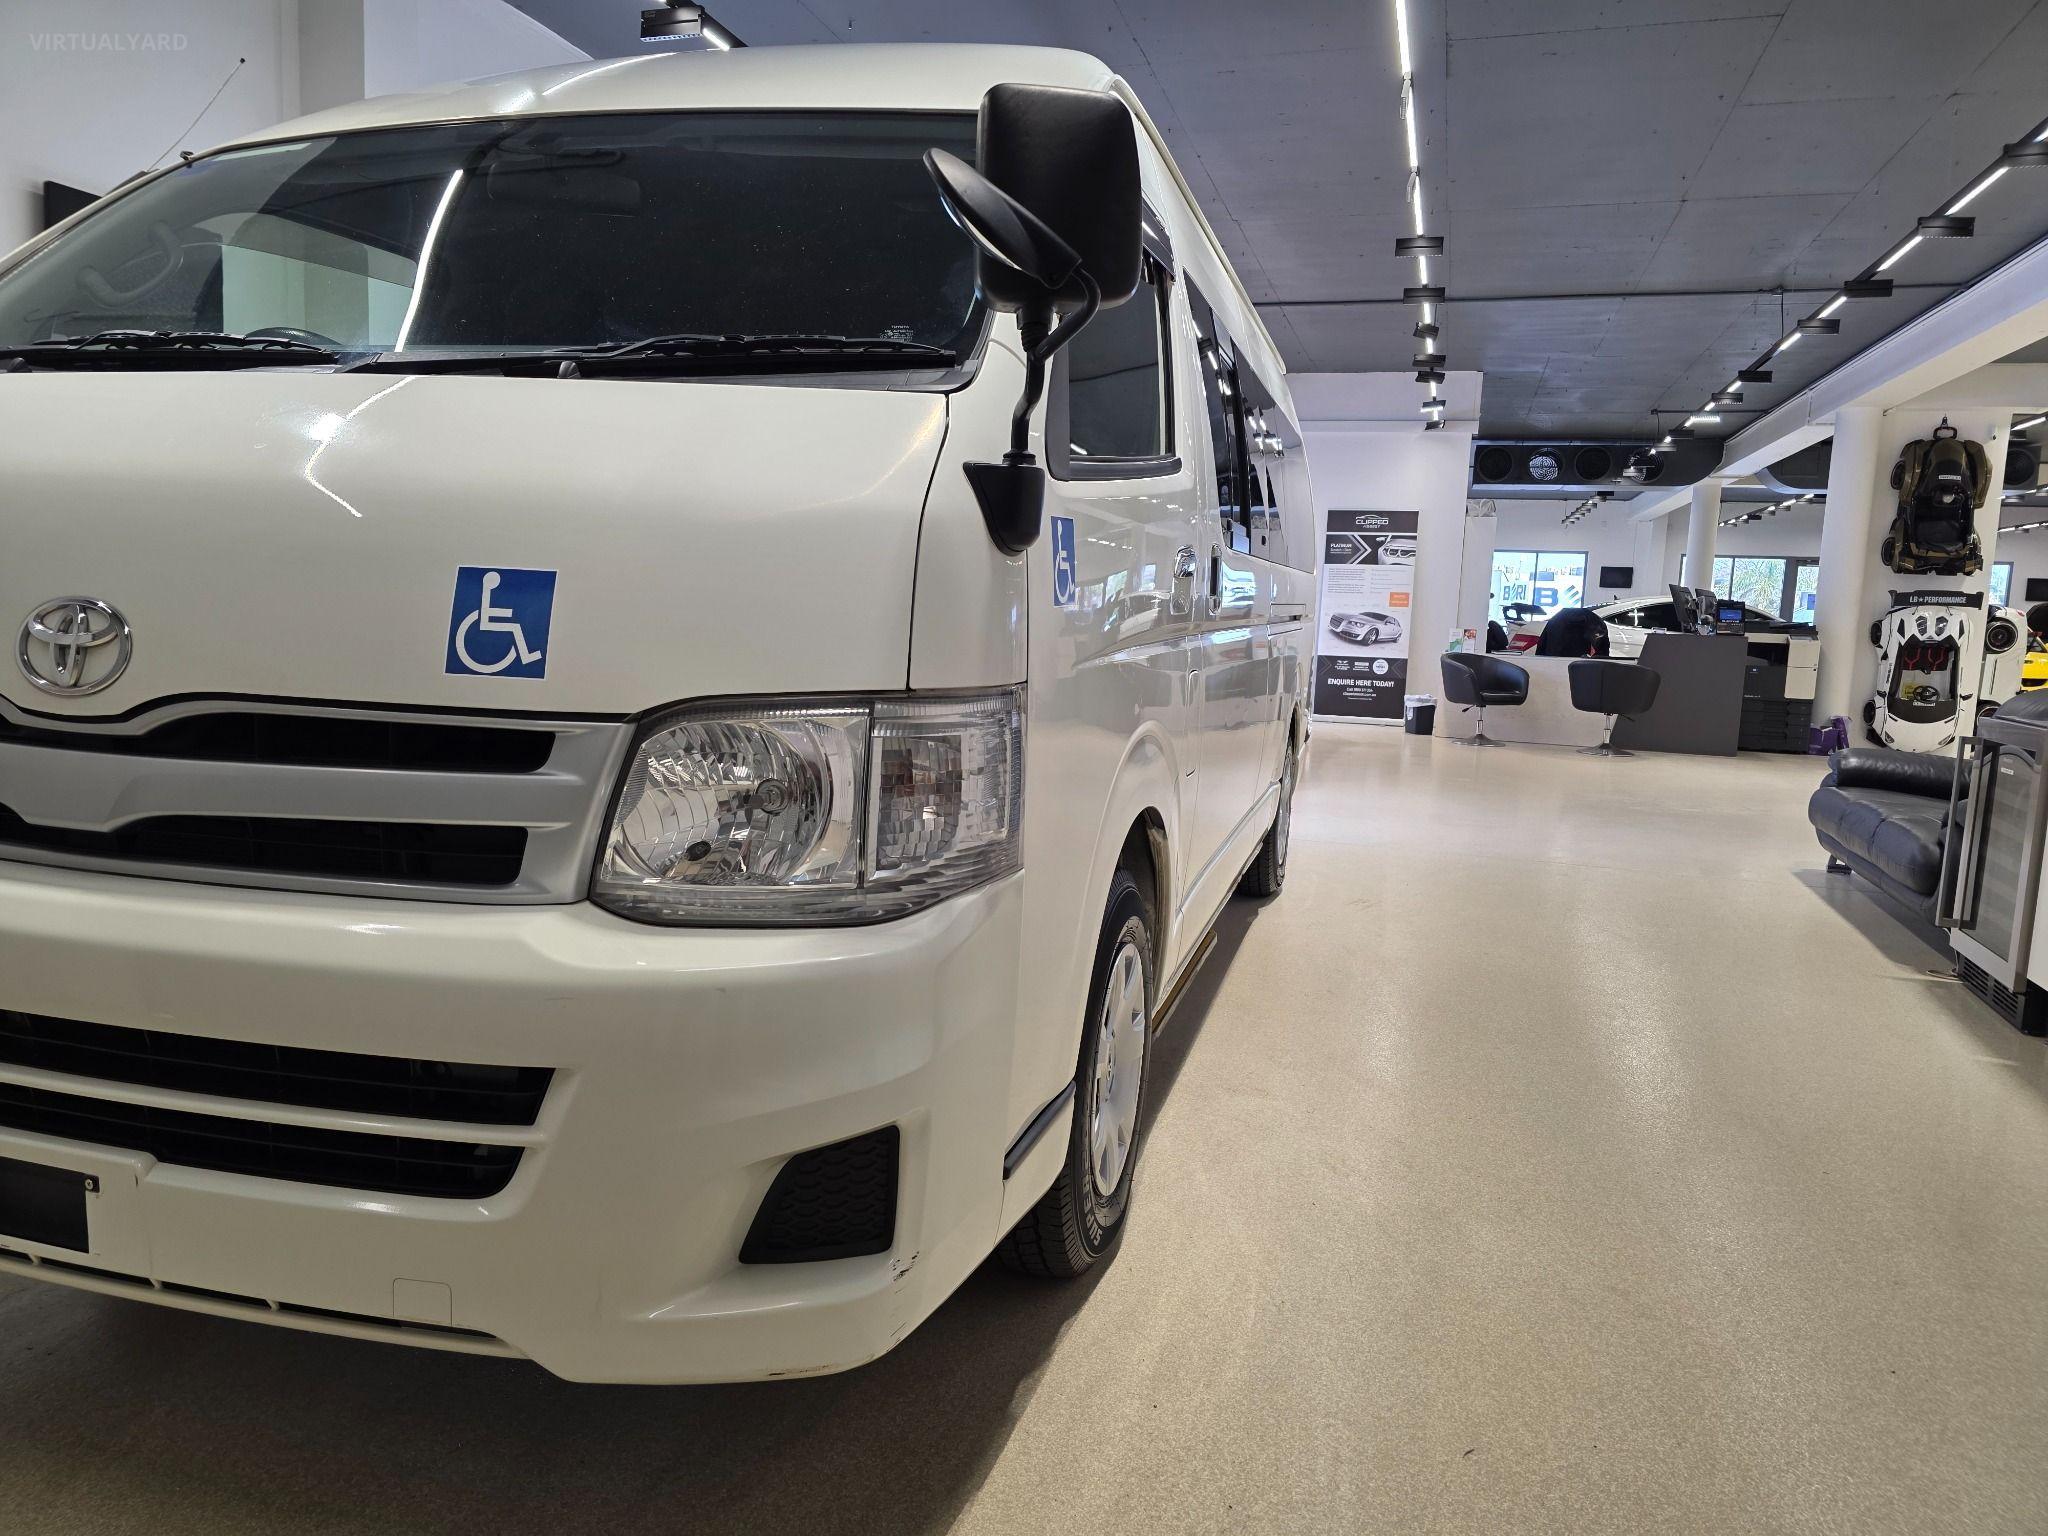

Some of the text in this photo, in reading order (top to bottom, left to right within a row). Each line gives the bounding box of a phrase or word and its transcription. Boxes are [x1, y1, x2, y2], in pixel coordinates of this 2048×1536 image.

[1909, 595, 1967, 604] LB PERFORMANCE
[1327, 678, 1395, 688] ENQUIRE HERE TODAY!
[1082, 1174, 1103, 1246] SUPER
